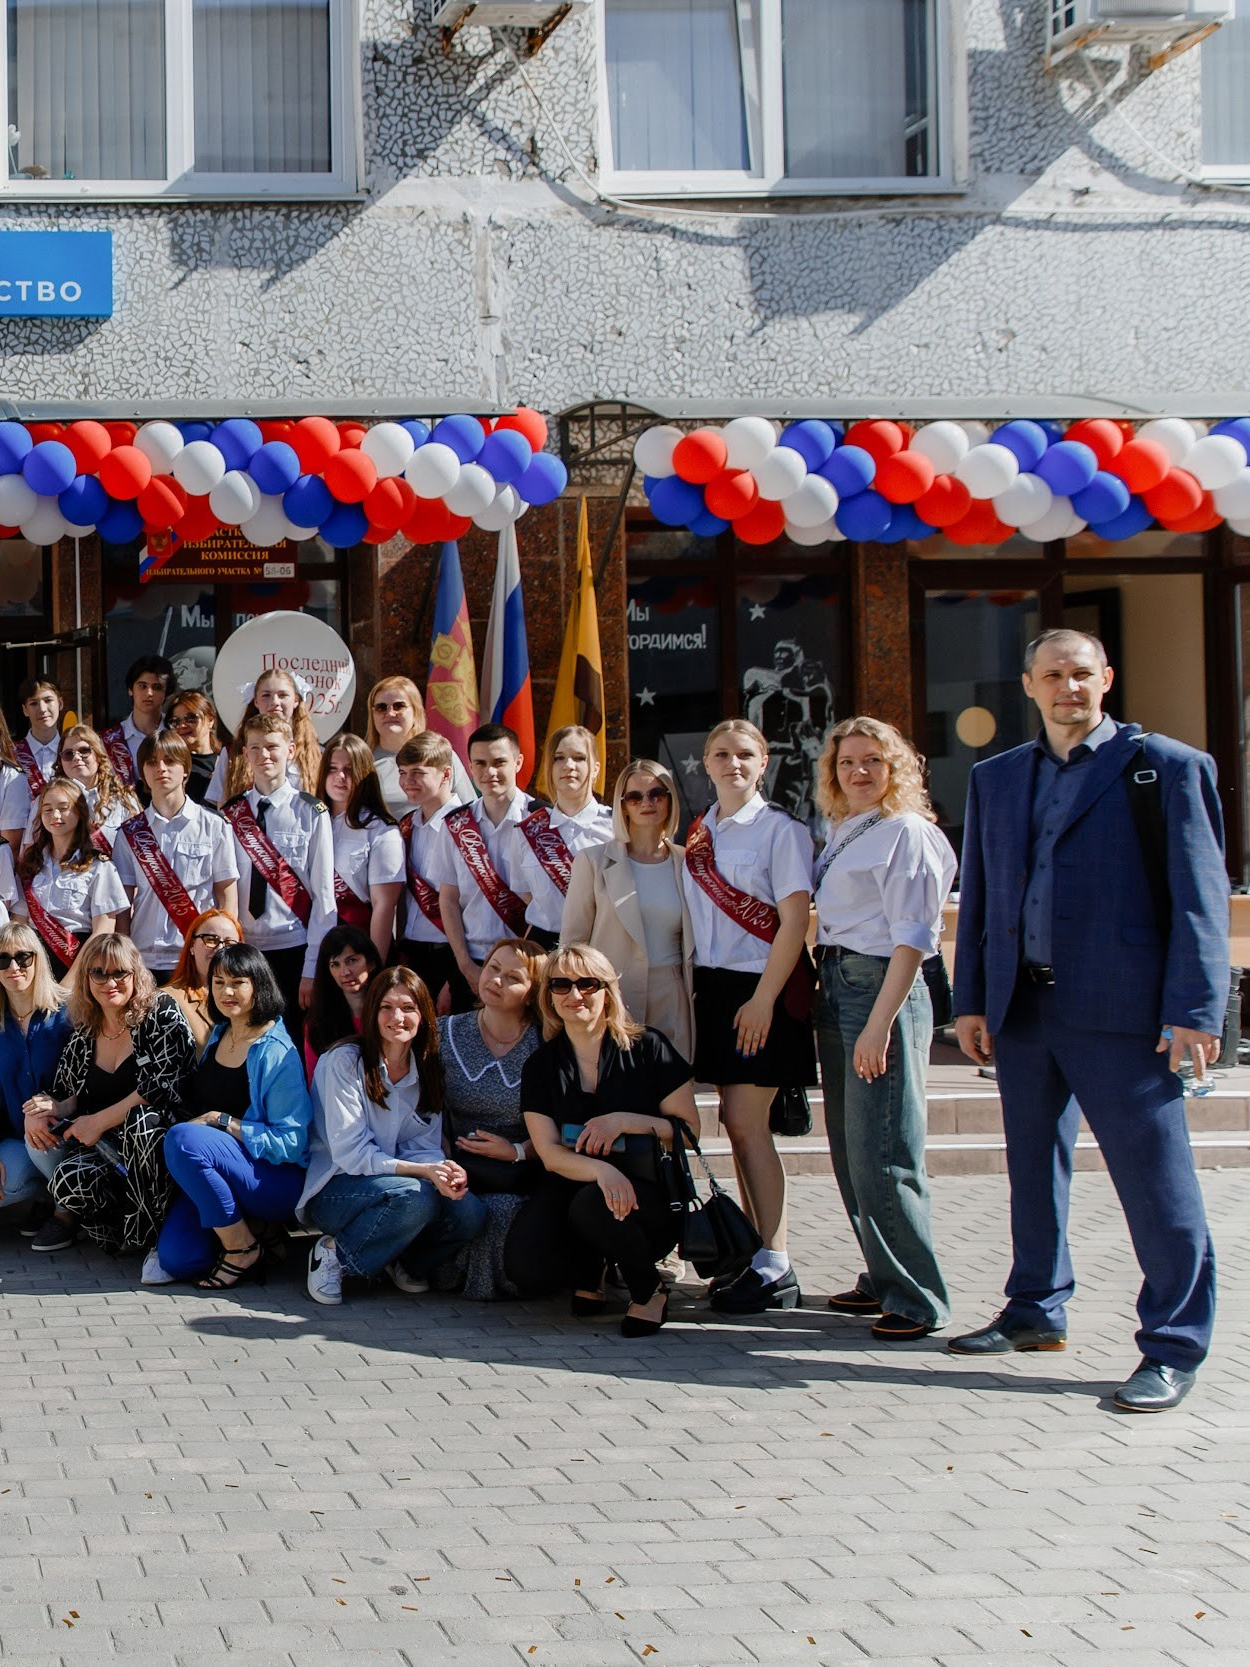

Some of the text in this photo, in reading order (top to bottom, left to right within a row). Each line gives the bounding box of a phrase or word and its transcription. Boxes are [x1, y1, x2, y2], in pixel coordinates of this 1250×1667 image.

[200, 550, 269, 561] КОМИССИЯ
[146, 566, 215, 576] ИЗБИРАТЕЛЬНОГО
[217, 566, 251, 576] УЧАСТКА
[181, 604, 215, 628] Мы
